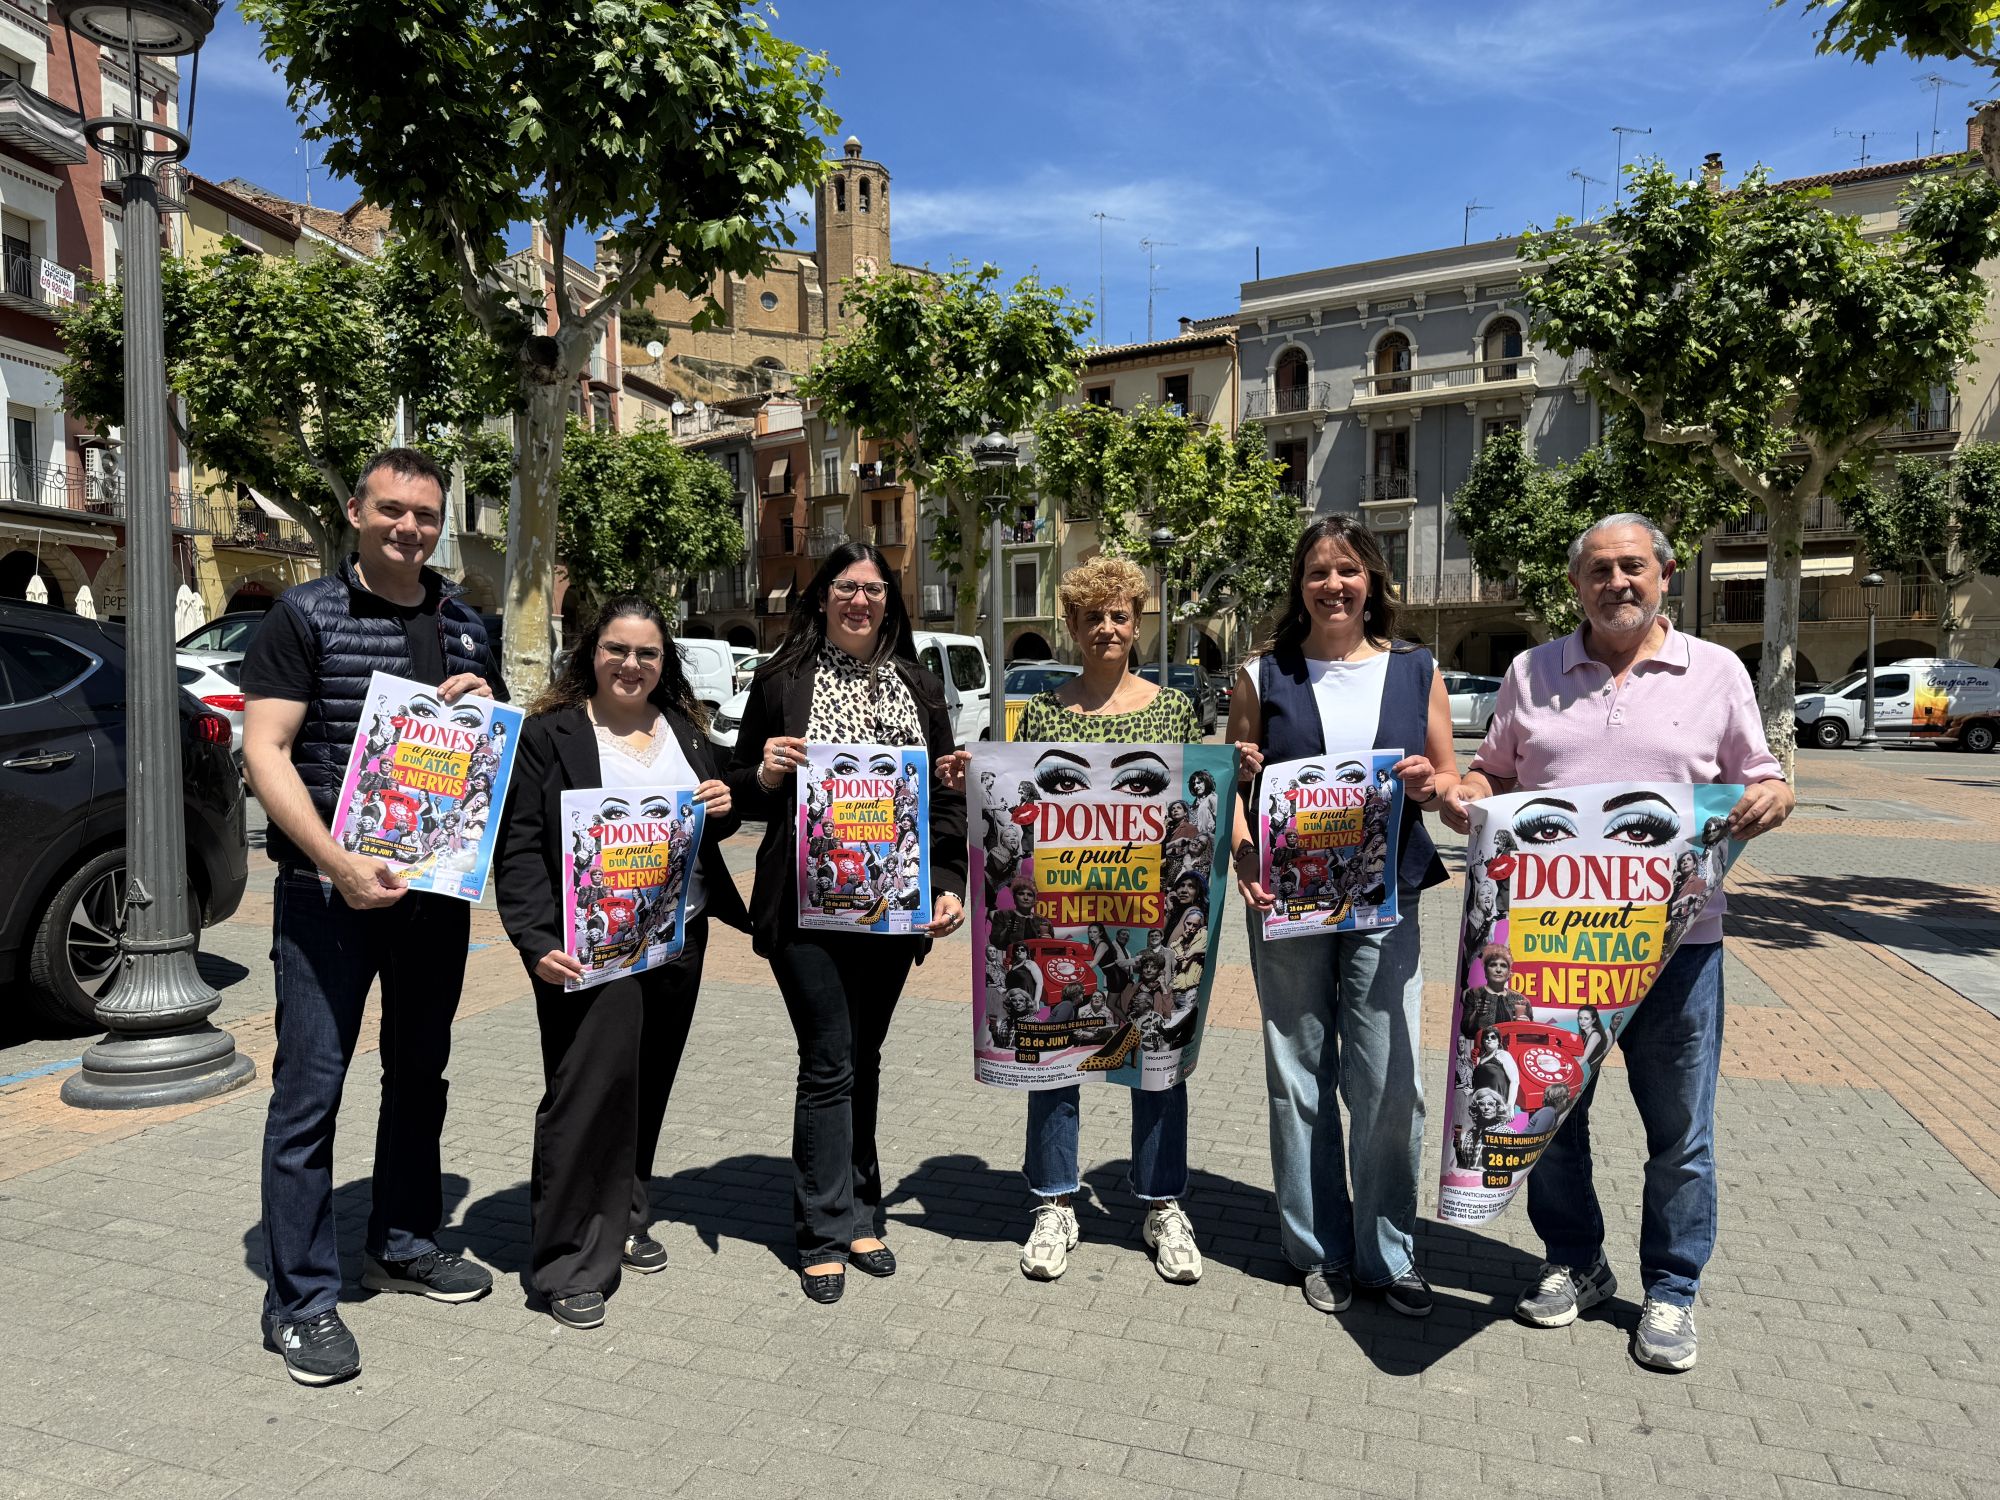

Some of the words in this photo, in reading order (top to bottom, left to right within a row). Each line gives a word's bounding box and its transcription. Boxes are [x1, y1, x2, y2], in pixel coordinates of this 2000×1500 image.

[44, 261, 71, 280] LLOGUER
[45, 270, 68, 286] OFICINA
[1927, 677, 1989, 690] CongesPan
[402, 716, 476, 752] DONES
[412, 746, 421, 754] a
[418, 747, 457, 760] punt
[402, 754, 422, 766] D'UN
[423, 757, 460, 776] ATAC
[391, 768, 404, 781] DE
[405, 769, 464, 796] NERVIS
[834, 778, 895, 798] DONES
[854, 798, 884, 812] punt
[1298, 787, 1365, 808] DONES
[840, 812, 857, 820] D'UN
[858, 810, 888, 822] ATAC
[1036, 802, 1165, 844] DONES
[1319, 807, 1353, 822] punt
[603, 822, 670, 846] DONES
[834, 830, 845, 839] DE
[846, 824, 894, 840] NERVIS
[1304, 822, 1322, 830] D'UN
[1324, 819, 1356, 832] ATAC
[1298, 838, 1310, 848] DE
[1311, 831, 1362, 849] NERVIS
[615, 848, 623, 856] a
[624, 843, 658, 858] punt
[1060, 850, 1076, 864] a
[1077, 842, 1142, 872] punt
[609, 858, 628, 868] D'UN
[630, 854, 662, 869] ATAC
[604, 876, 614, 886] DE
[618, 868, 667, 888] NERVIS
[1046, 868, 1082, 886] D'UN
[1086, 866, 1148, 890] ATAC
[1512, 853, 1672, 902] DONES
[1036, 900, 1057, 920] DE
[1061, 894, 1160, 924] NERVIS
[1539, 909, 1560, 925] a
[1561, 902, 1646, 936] punt
[1523, 933, 1568, 953] D'UN
[1572, 931, 1650, 962] ATAC
[1510, 972, 1537, 997] DE
[1542, 966, 1657, 1004] NERVIS
[1018, 1023, 1038, 1031] TEATRE
[1039, 1024, 1068, 1032] MUNICIPAL
[1075, 1018, 1104, 1028] BALAGUER
[1020, 1037, 1030, 1046] 28
[1033, 1038, 1045, 1047] de
[1046, 1036, 1070, 1046] JUNY
[1018, 1053, 1036, 1061] 19:00
[1485, 1134, 1513, 1145] TEATRE
[1513, 1134, 1545, 1146] MUNICIPAL
[1488, 1154, 1504, 1166] 28
[1506, 1155, 1520, 1166] de
[1487, 1176, 1508, 1186] 19:00
[1462, 1190, 1497, 1198] ANTICIPADA
